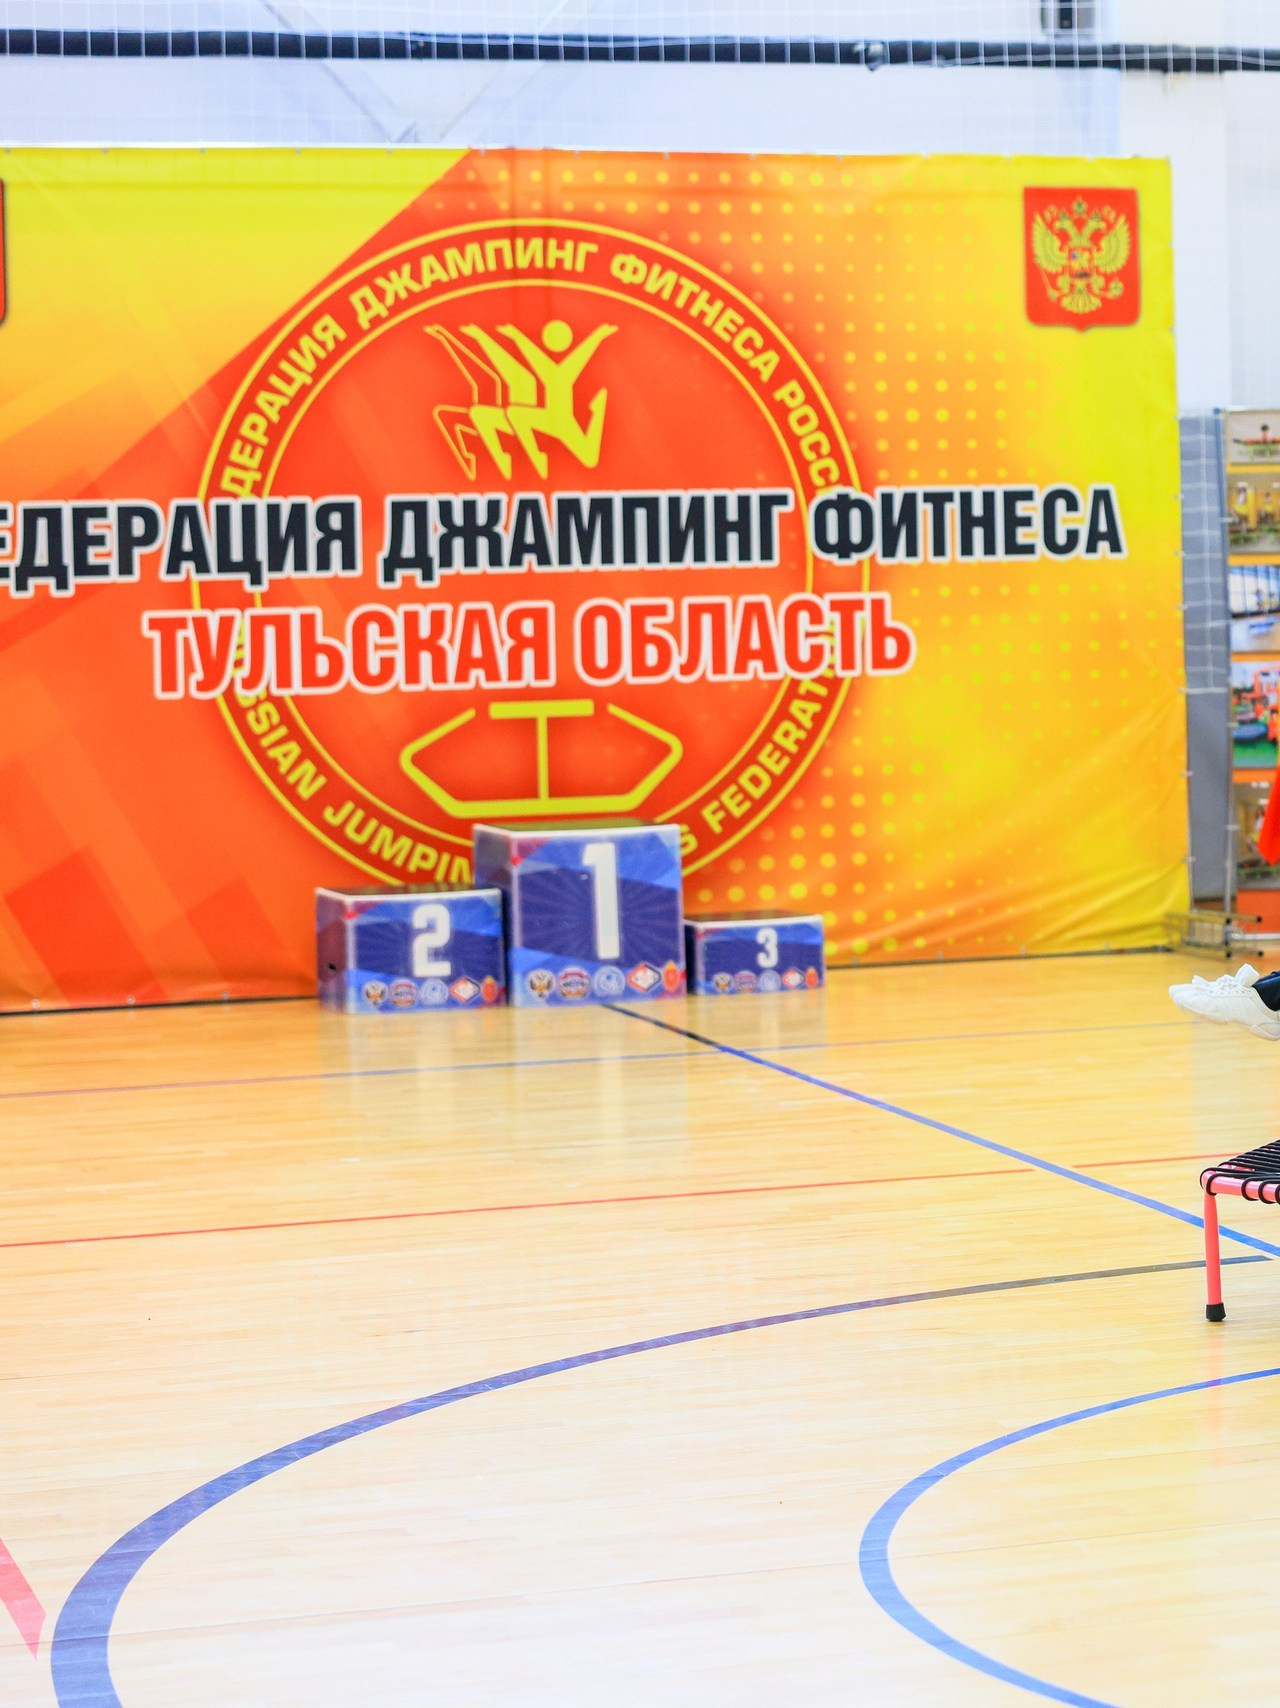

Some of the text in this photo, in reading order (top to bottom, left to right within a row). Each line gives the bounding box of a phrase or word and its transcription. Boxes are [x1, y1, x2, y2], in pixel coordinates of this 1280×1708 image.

[220, 237, 841, 498] ДЕРАЦИЯ ДЖАМПИНГ ФИТНЕСА РОСС
[0, 486, 1126, 595] ДЕРАЦИЯ ДЖАМПИНГ ФИТНЕСА
[144, 593, 916, 697] ТУЛЬСКАЯ ОБЛАСТЬ
[701, 667, 836, 835] FEDERAT
[321, 799, 474, 885] JUMPIN
[411, 902, 452, 978] 2
[582, 841, 620, 960] 1
[756, 927, 779, 968] 3
